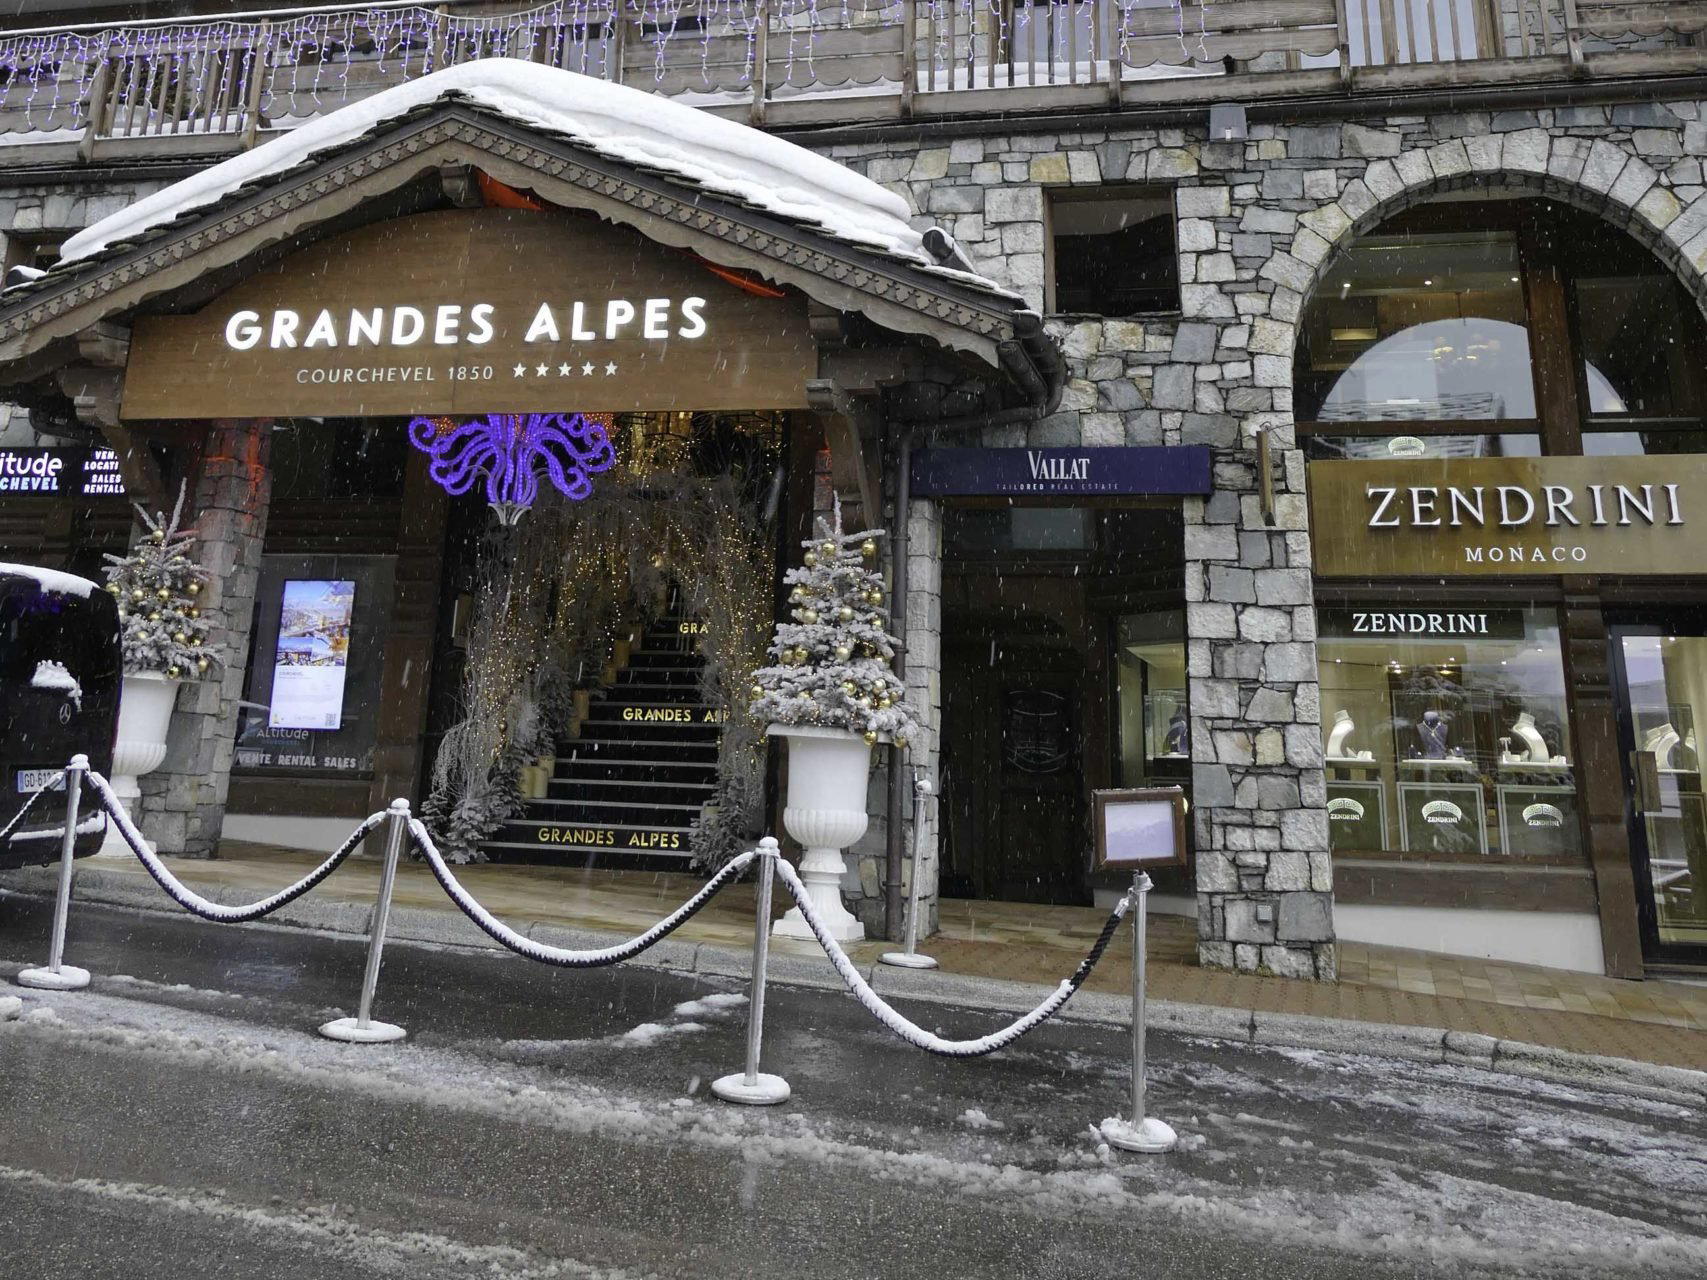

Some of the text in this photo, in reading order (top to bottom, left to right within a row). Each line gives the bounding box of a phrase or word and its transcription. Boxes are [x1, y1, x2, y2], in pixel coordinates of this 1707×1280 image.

[225, 297, 707, 350] GRANDES ALPES
[297, 365, 493, 383] COURCHEVEL 1850
[95, 451, 118, 460] VEN
[1027, 450, 1090, 480] VALLAT
[91, 474, 122, 483] SALES
[1366, 483, 1685, 527] ZENDRINI
[1465, 547, 1587, 562] MONACO
[1352, 613, 1489, 633] ZENDRINI
[623, 707, 691, 722] GRANDES
[278, 754, 317, 767] RENTAL
[324, 756, 357, 769] SALES
[538, 827, 680, 848] GRANDES ALPES
